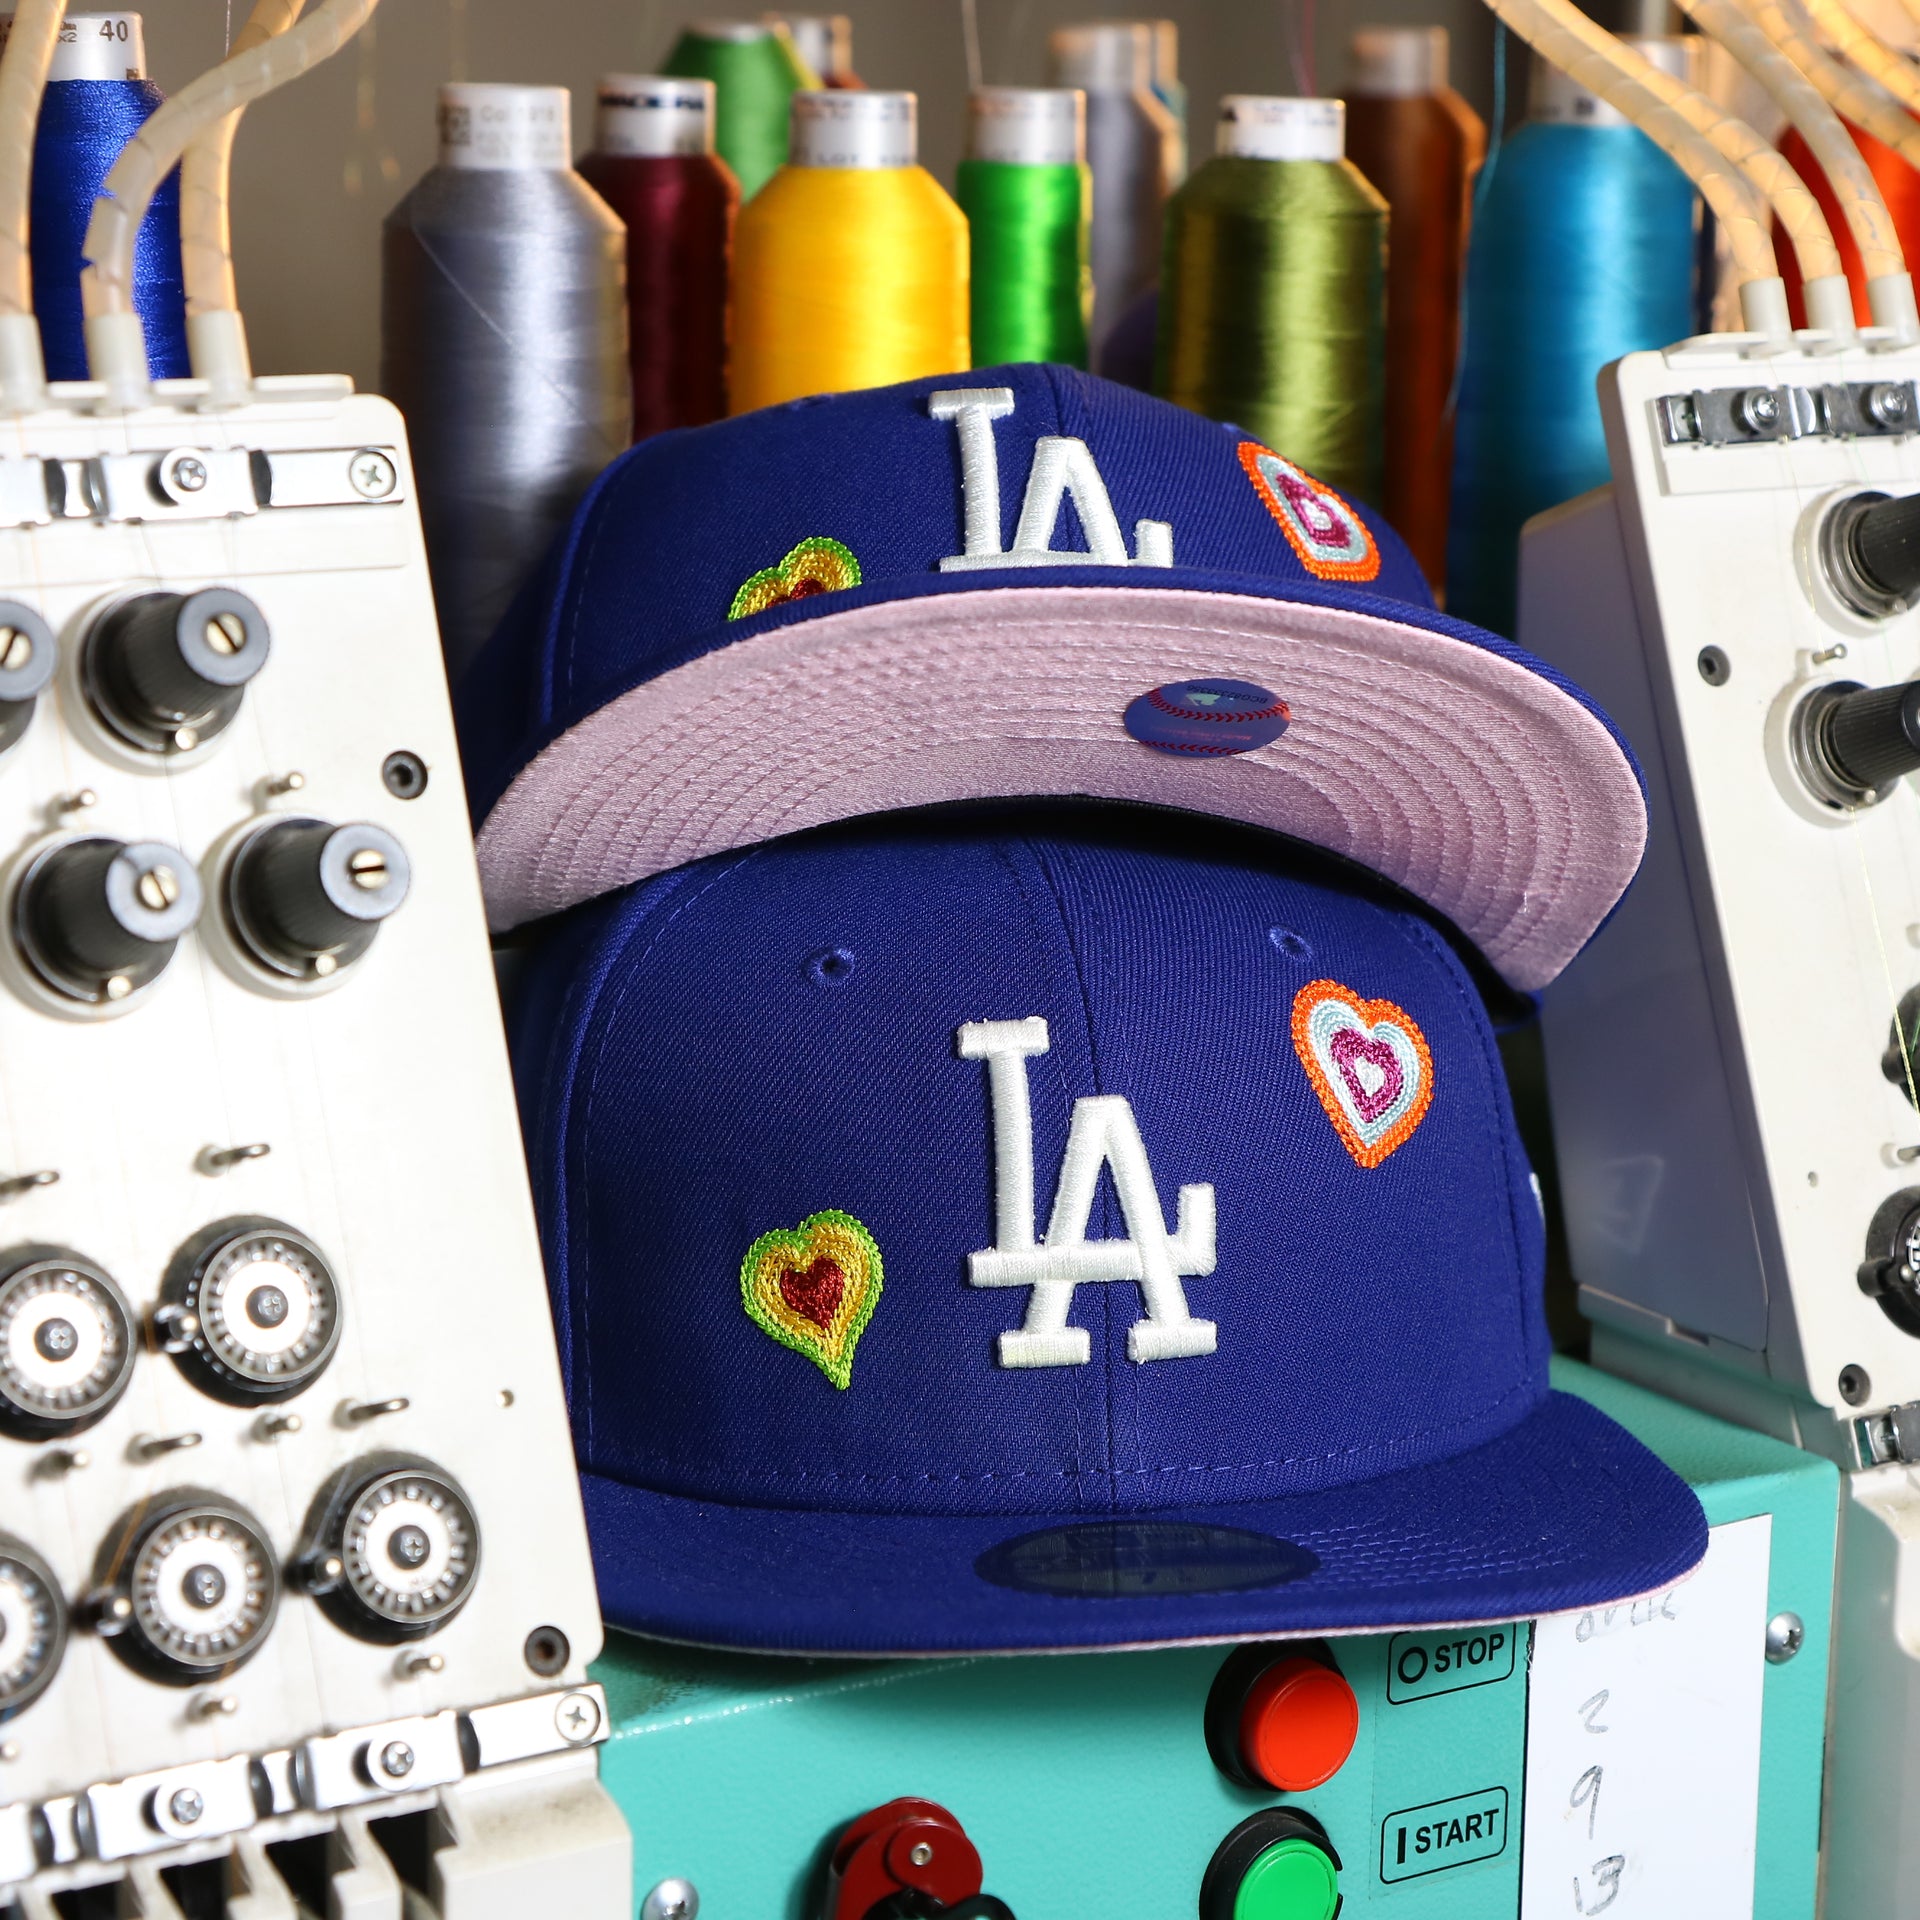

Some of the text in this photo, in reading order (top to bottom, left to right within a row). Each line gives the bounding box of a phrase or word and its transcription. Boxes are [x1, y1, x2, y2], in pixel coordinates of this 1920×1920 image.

[99, 20, 129, 42] 40
[928, 387, 1174, 573] LA
[957, 1015, 1218, 1369] LA
[1433, 1632, 1506, 1673] STOP
[1578, 1688, 1610, 1734] 2
[1569, 1764, 1604, 1841] 9
[1414, 1808, 1500, 1855] START
[1572, 1853, 1626, 1917] 13
